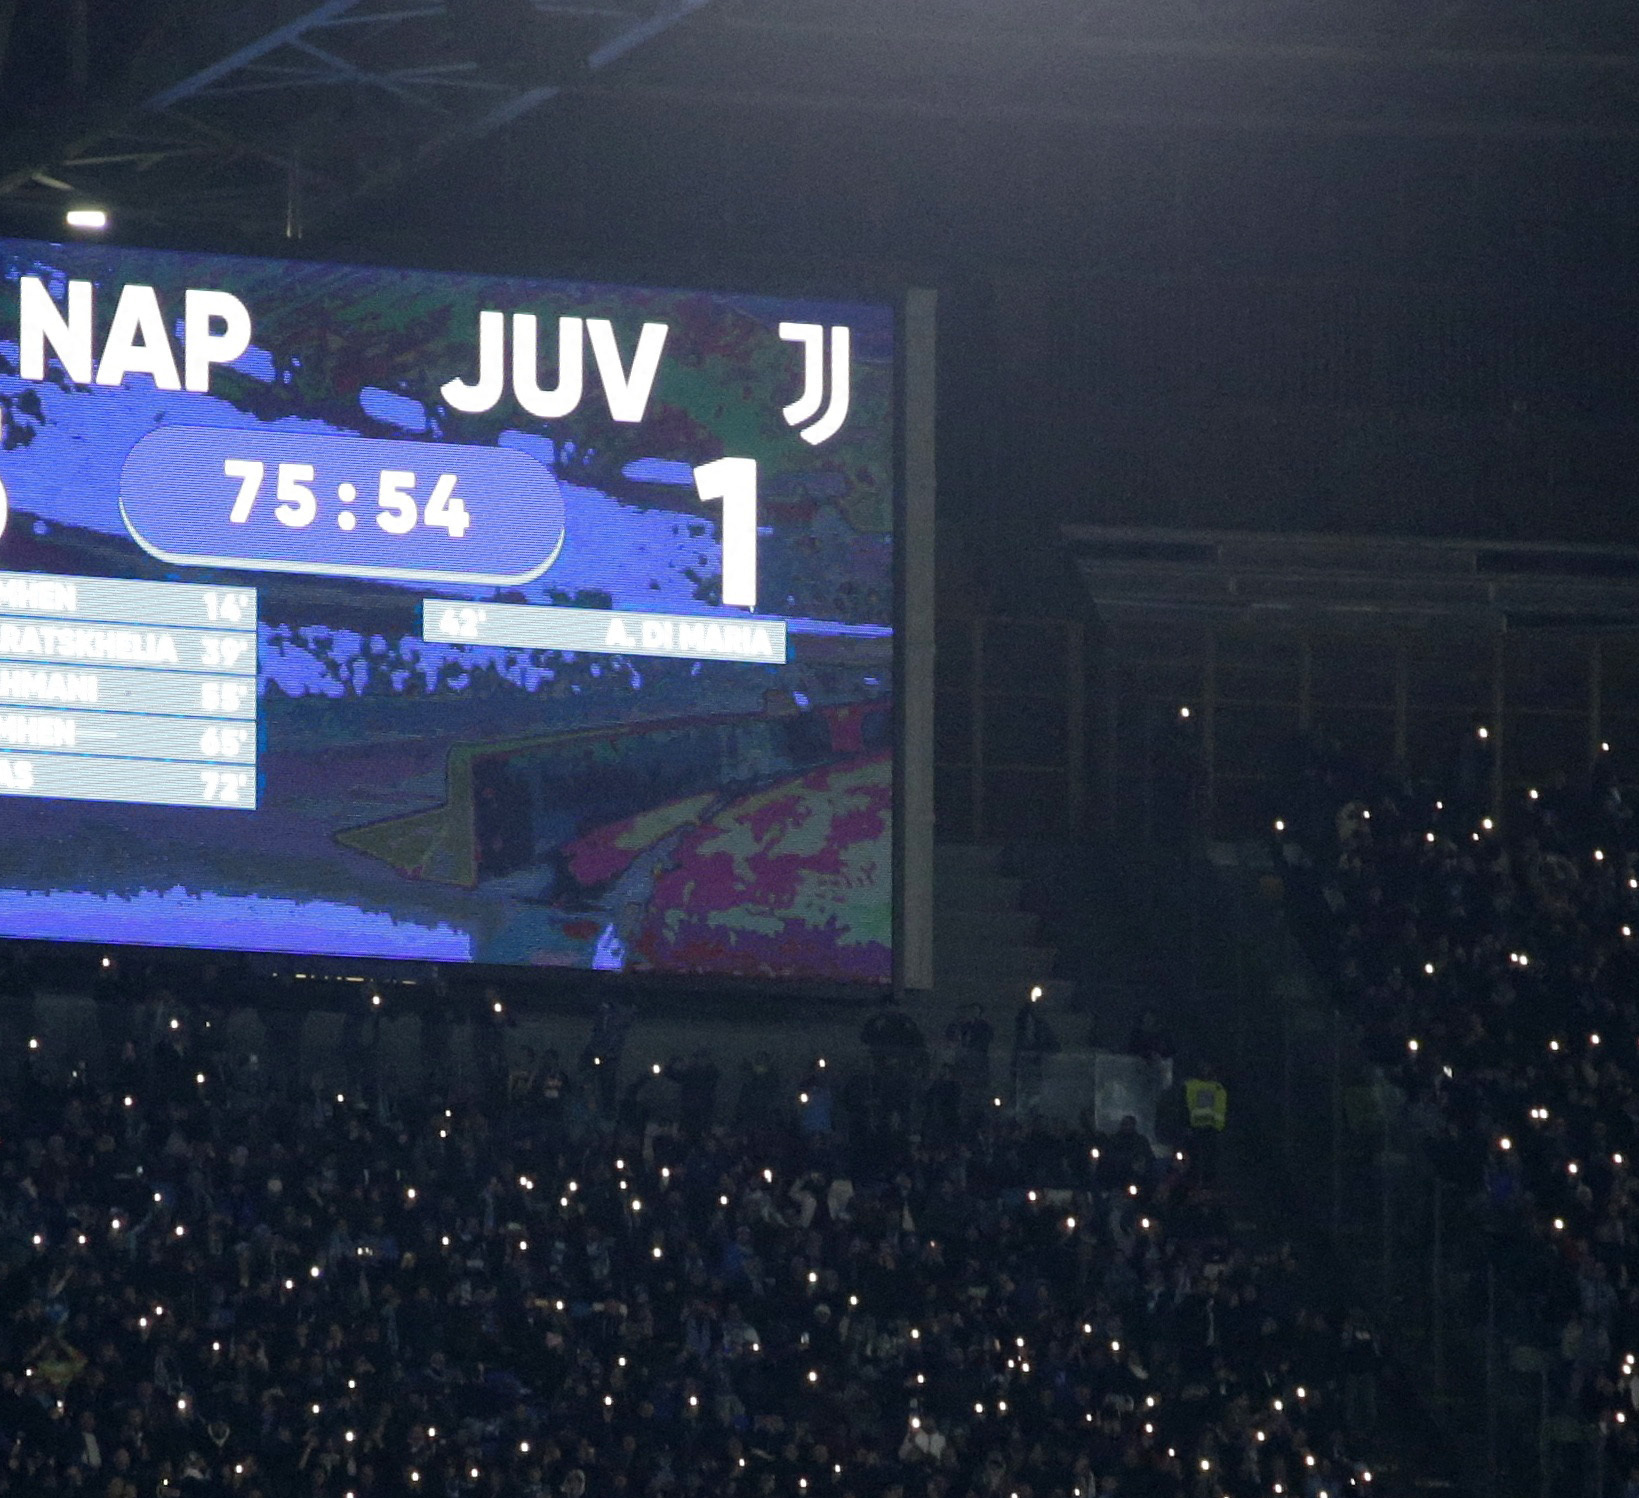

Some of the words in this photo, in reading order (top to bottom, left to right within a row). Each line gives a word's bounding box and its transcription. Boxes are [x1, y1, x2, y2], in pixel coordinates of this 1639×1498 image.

[19, 275, 252, 393] NAP
[440, 311, 670, 422] JUV
[222, 458, 472, 538] 75:54
[692, 457, 759, 609] 1
[642, 620, 673, 650] DI
[678, 622, 773, 656] MARIA
